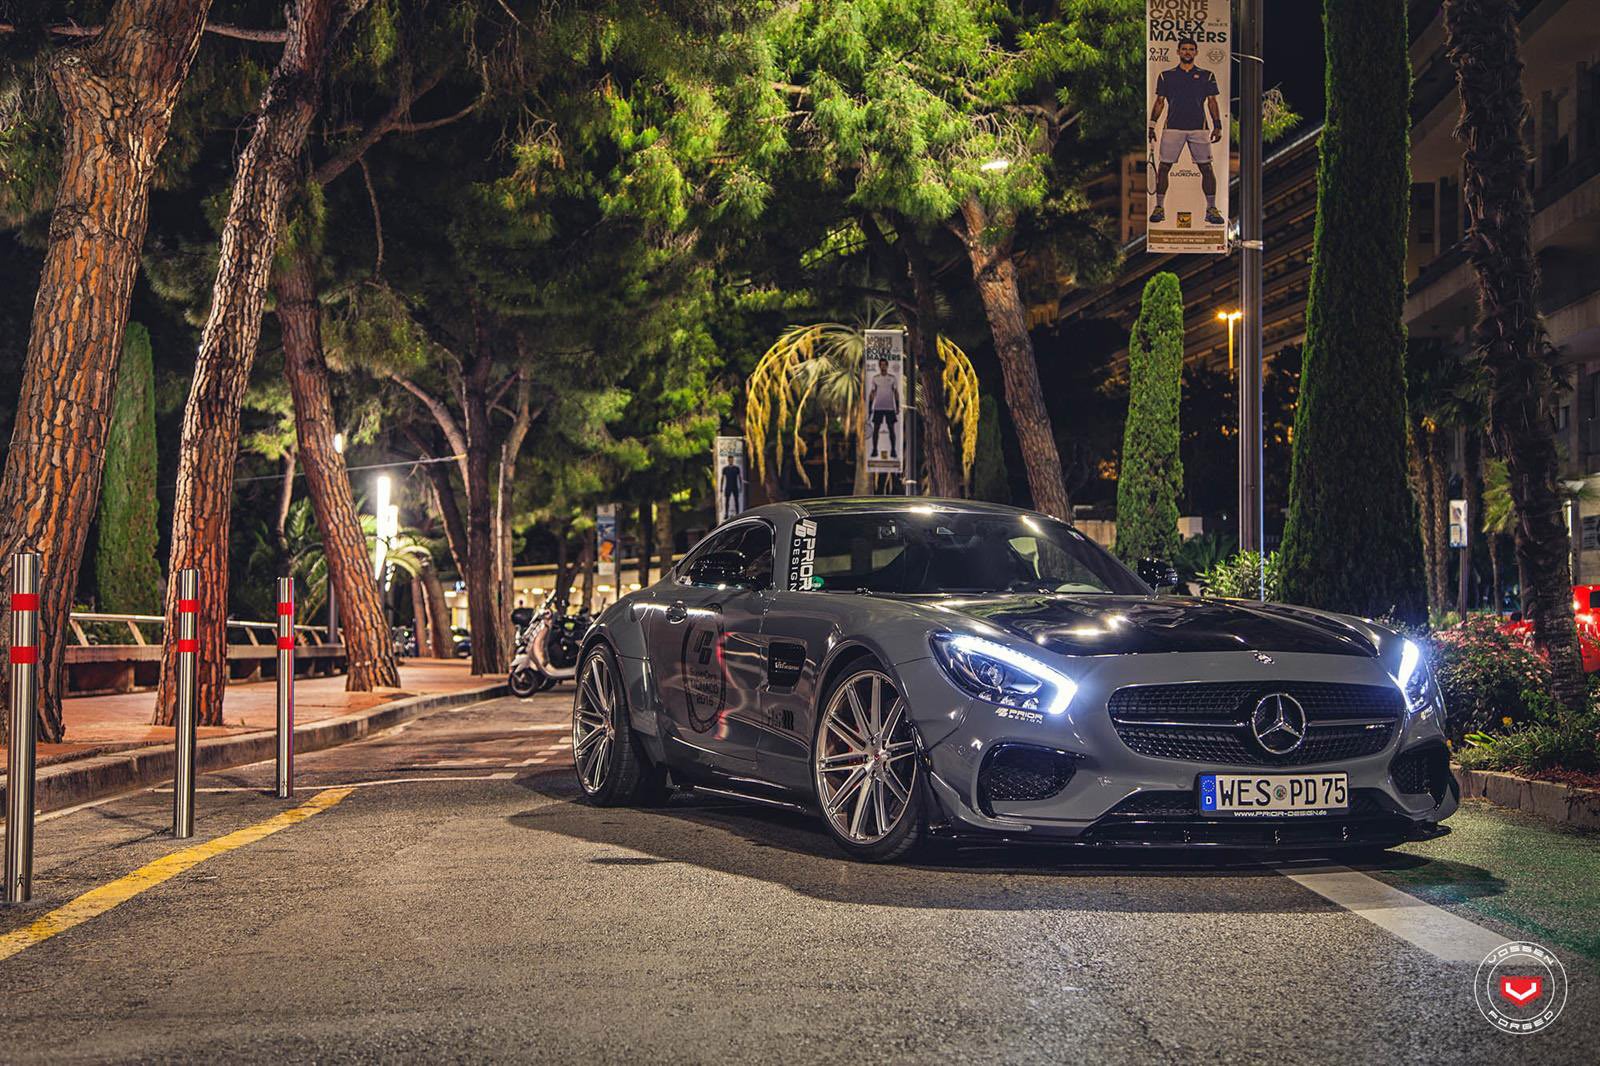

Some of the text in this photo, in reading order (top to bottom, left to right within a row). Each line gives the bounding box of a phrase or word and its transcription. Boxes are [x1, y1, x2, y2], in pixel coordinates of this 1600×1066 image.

[1149, 0, 1208, 10] MONTE
[1149, 9, 1207, 20] CARLO
[1149, 20, 1205, 31] ROLEX
[1150, 31, 1227, 43] MASTERS
[1149, 47, 1169, 56] 9-17
[789, 539, 801, 592] DESIGN
[799, 538, 816, 591] PRIOR
[1219, 778, 1346, 806] WES PD 75
[1205, 796, 1212, 805] D
